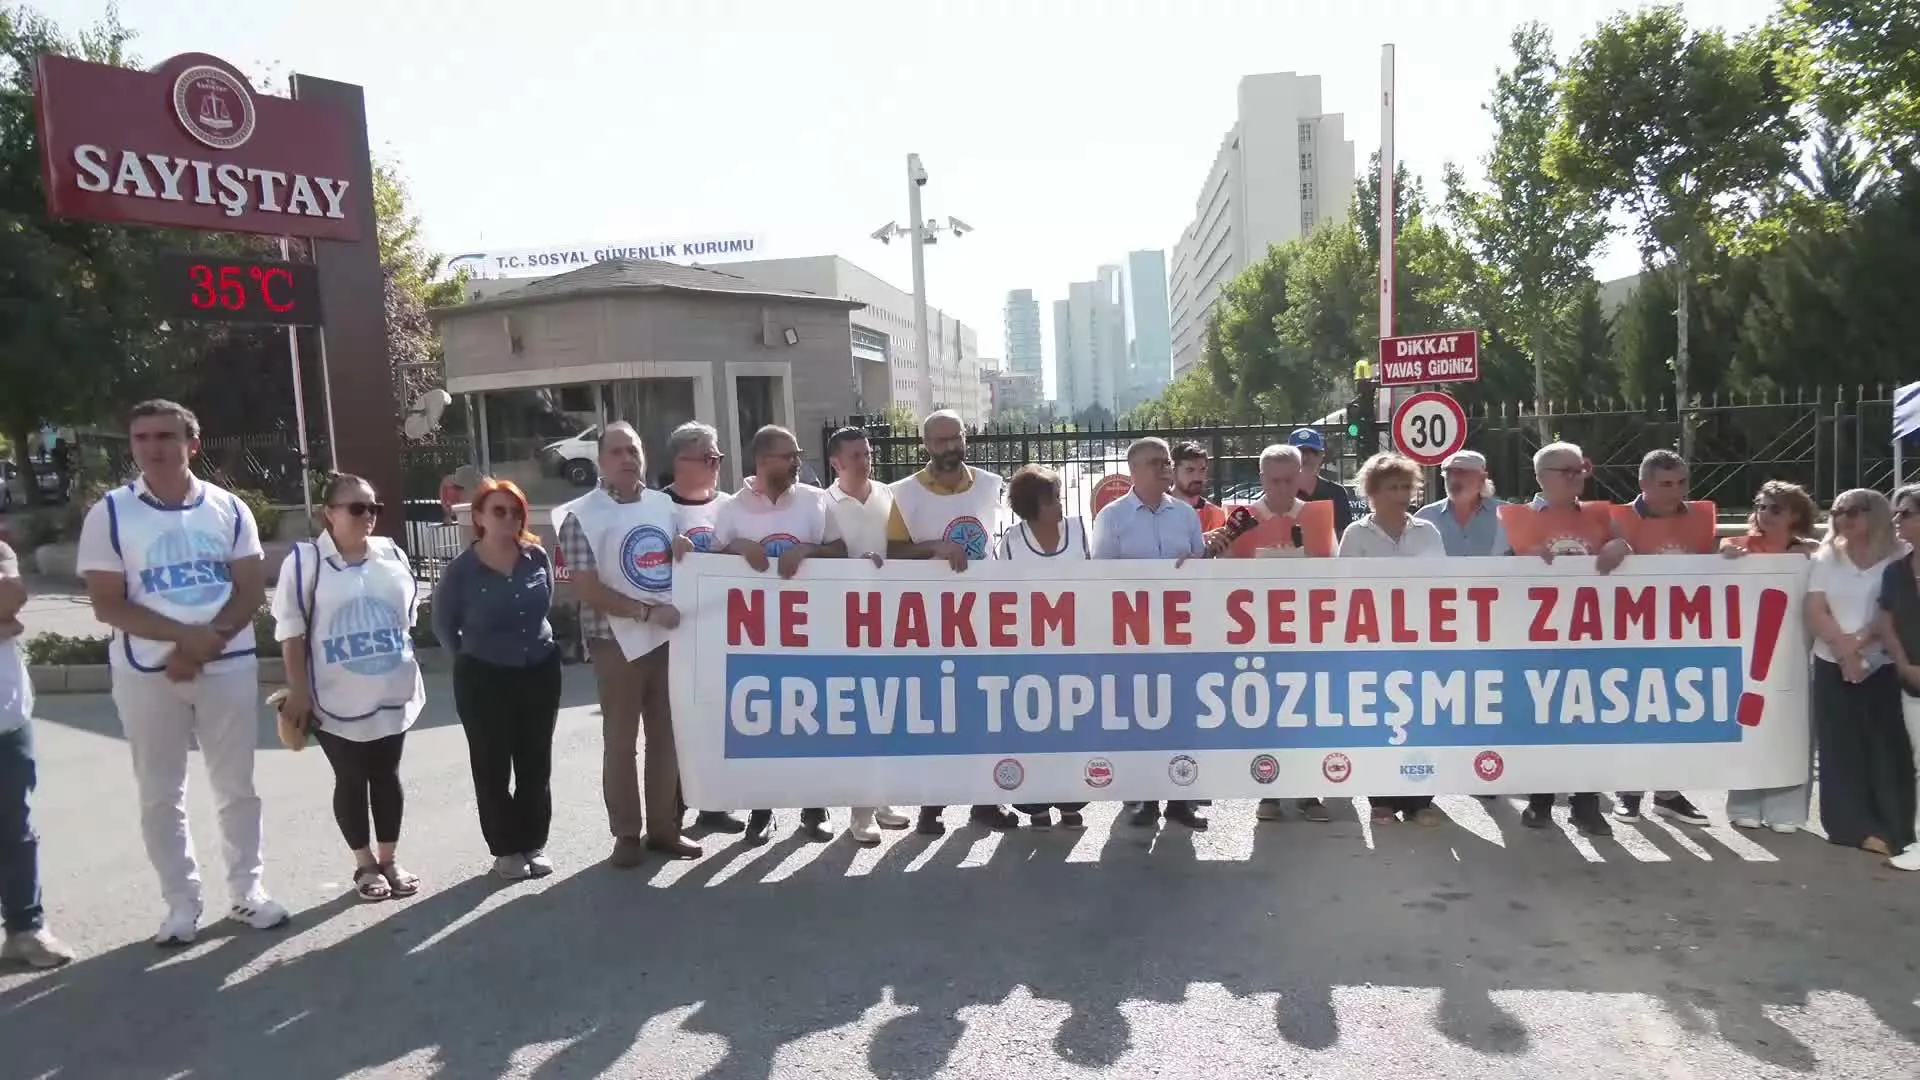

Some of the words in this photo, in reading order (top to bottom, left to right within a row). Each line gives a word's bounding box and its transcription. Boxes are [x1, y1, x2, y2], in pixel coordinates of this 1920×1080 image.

[73, 144, 350, 217] SAYIŞTAY
[496, 256, 524, 269] T.C.
[528, 251, 588, 267] SOSYAL
[594, 245, 677, 263] GÜVENLİK
[683, 239, 755, 256] KURUMU
[1396, 336, 1459, 357] DİKKAT
[1384, 361, 1422, 380] YAVAŞ
[1410, 414, 1447, 449] 30
[728, 591, 807, 646] NE
[847, 591, 1075, 647] HAKEM
[1114, 591, 1192, 645] NE
[1228, 587, 1499, 644] SEFALET
[730, 659, 956, 736] GREVLİ
[977, 673, 1171, 733] TOPLU
[1196, 656, 1503, 746] SÖZLEŞME
[1525, 667, 1729, 725] YASASI
[1399, 765, 1435, 775] KESK
